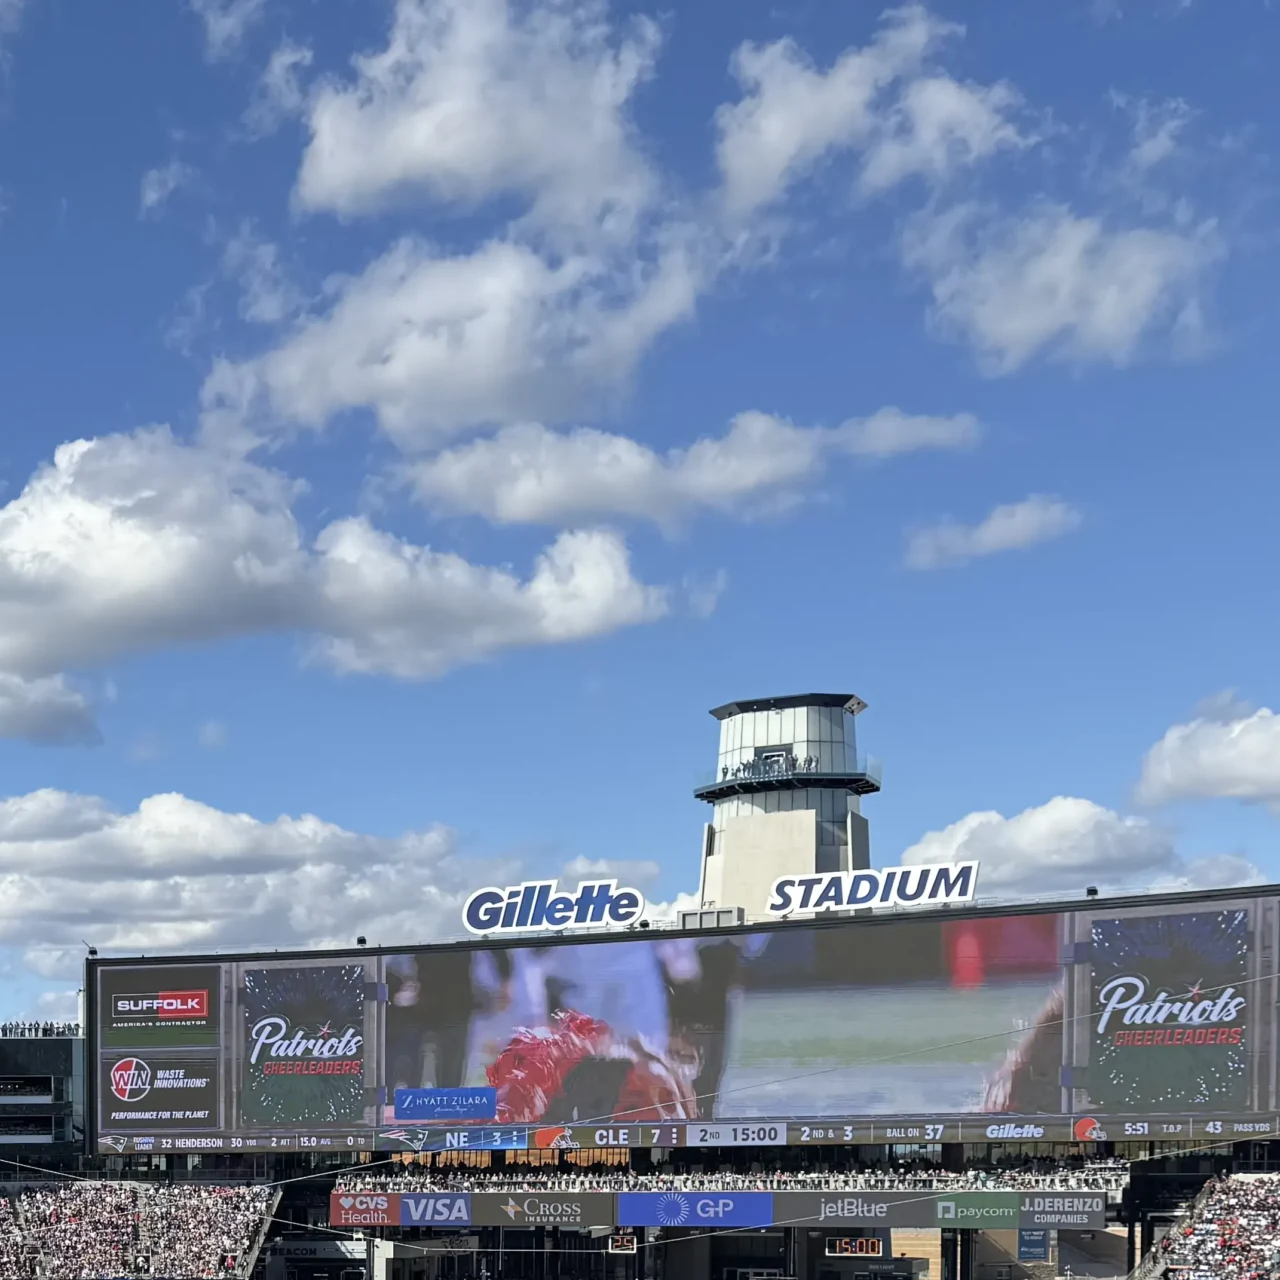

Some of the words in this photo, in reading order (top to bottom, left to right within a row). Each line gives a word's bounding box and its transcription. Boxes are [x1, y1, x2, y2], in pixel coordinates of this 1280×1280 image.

[767, 863, 975, 913] STADIUM
[466, 882, 642, 931] Gillette
[117, 999, 200, 1010] SUFFOLK
[1096, 976, 1247, 1035] Patriots
[250, 1017, 363, 1063] Patriots
[1113, 1027, 1242, 1047] CHEERLEADERS
[157, 1069, 185, 1079] WASTE
[263, 1060, 361, 1075] CHEERLEADERS
[113, 1070, 148, 1089] WIN
[153, 1078, 208, 1088] INNOVATIONS
[416, 1096, 448, 1106] HYATT
[452, 1095, 488, 1105] ZILARA
[111, 1111, 157, 1120] PERFORMANCE
[158, 1111, 170, 1119] FOR
[185, 1110, 209, 1118] PLANET
[699, 1128, 720, 1142] 2ND
[732, 1126, 778, 1142] 15:00
[843, 1126, 853, 1140] 3
[886, 1128, 905, 1137] BALL
[907, 1127, 919, 1137] ON
[924, 1124, 944, 1140] 37
[986, 1123, 1044, 1139] Gillette
[1124, 1123, 1149, 1135] 5:51
[1206, 1121, 1223, 1134] 43
[1234, 1123, 1253, 1132] PASS
[1254, 1122, 1270, 1132] YDS
[161, 1139, 172, 1148] 32
[175, 1138, 223, 1148] HENDERSON
[231, 1138, 243, 1147] 30
[271, 1137, 277, 1147] 2
[300, 1137, 317, 1147] 15.0
[347, 1136, 353, 1146] 0
[445, 1132, 469, 1147] NE
[493, 1131, 502, 1146] 3
[595, 1129, 629, 1145] CLE
[651, 1128, 660, 1143] 7
[355, 1196, 388, 1210] CVS
[407, 1198, 469, 1221] VISA
[819, 1198, 888, 1220] jetBlue
[1021, 1198, 1103, 1212] J.DERENZO
[957, 1203, 1014, 1219] paycom
[1034, 1214, 1089, 1224] COMPANIES
[613, 1237, 632, 1250] 25
[836, 1239, 878, 1254] 15:00
[270, 1247, 317, 1257] BEACON
